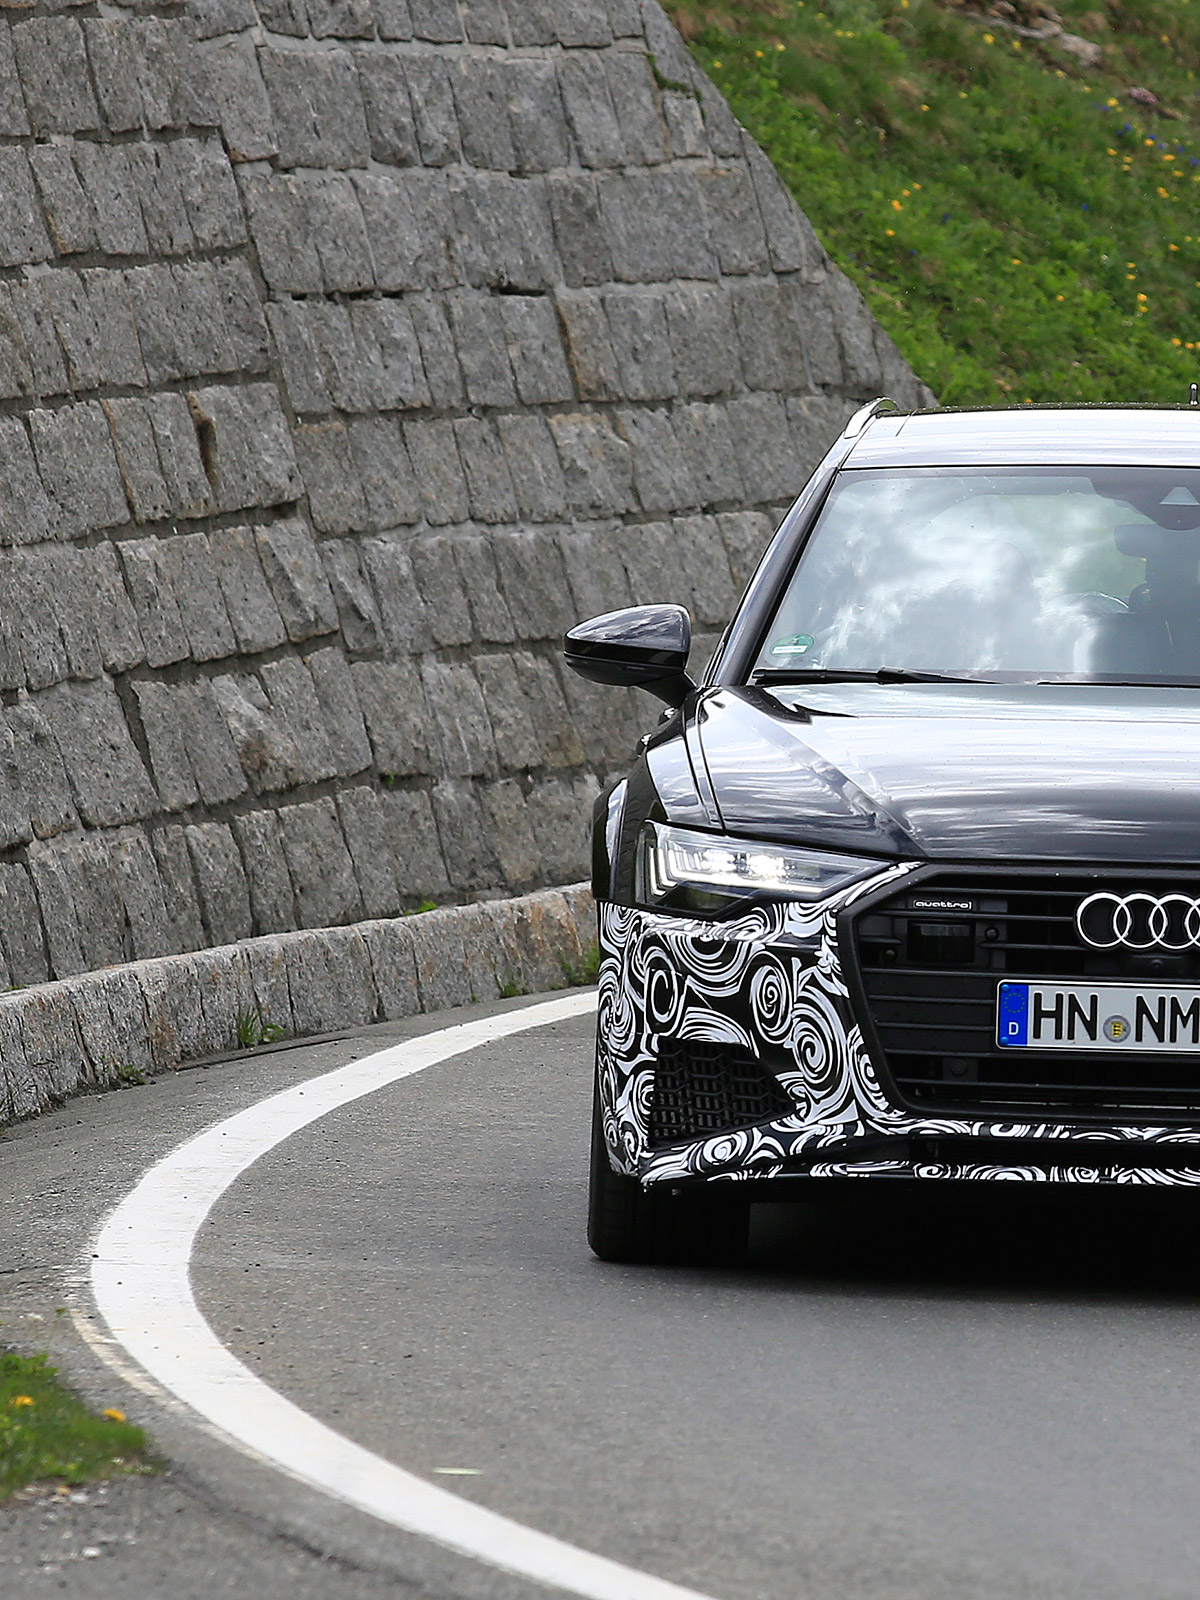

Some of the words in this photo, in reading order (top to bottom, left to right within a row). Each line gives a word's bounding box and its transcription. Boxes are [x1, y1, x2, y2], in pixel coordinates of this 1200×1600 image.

[914, 901, 970, 909] quattro
[1033, 992, 1098, 1041] HN
[1135, 994, 1200, 1043] NM
[1008, 1022, 1019, 1035] D
